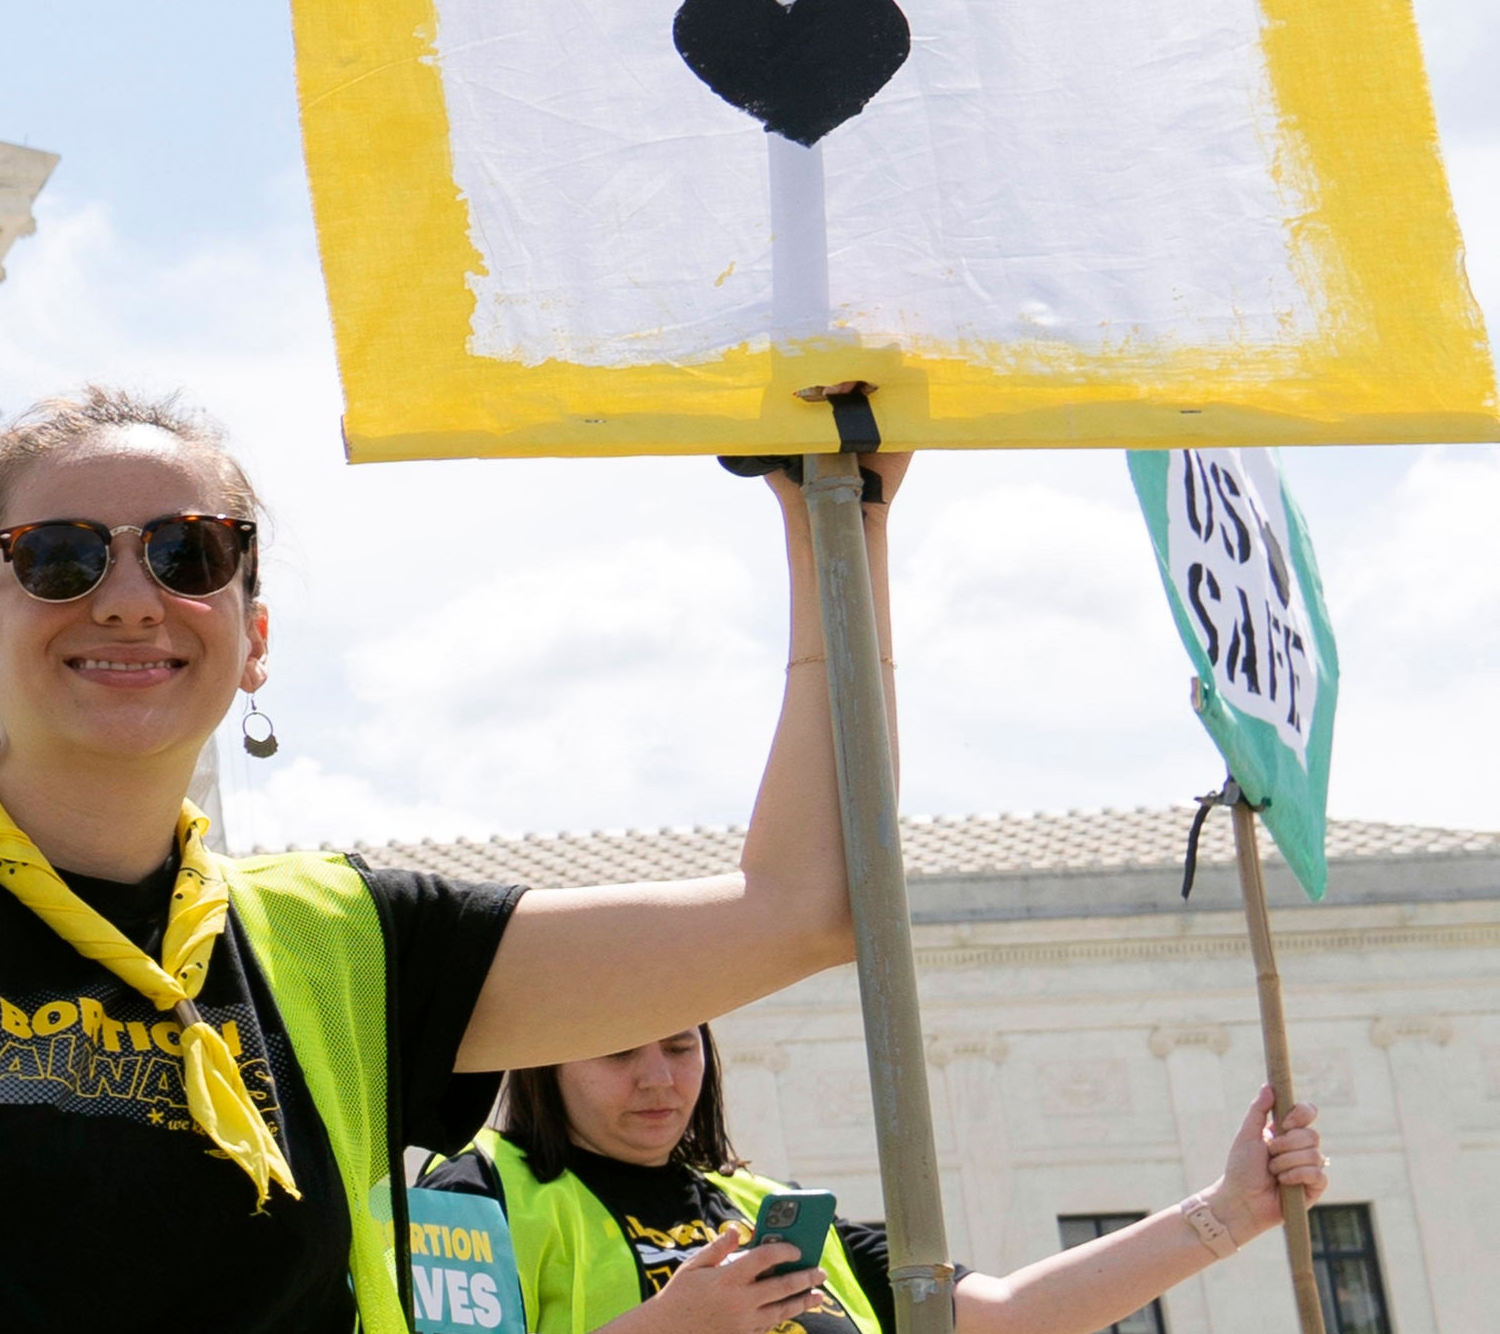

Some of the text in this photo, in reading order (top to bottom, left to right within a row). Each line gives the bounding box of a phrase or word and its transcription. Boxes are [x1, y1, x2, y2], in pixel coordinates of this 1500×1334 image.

[1182, 449, 1251, 565] US
[1187, 562, 1305, 733] SAFE
[388, 1220, 494, 1264] RTION
[411, 1264, 503, 1329] VES
